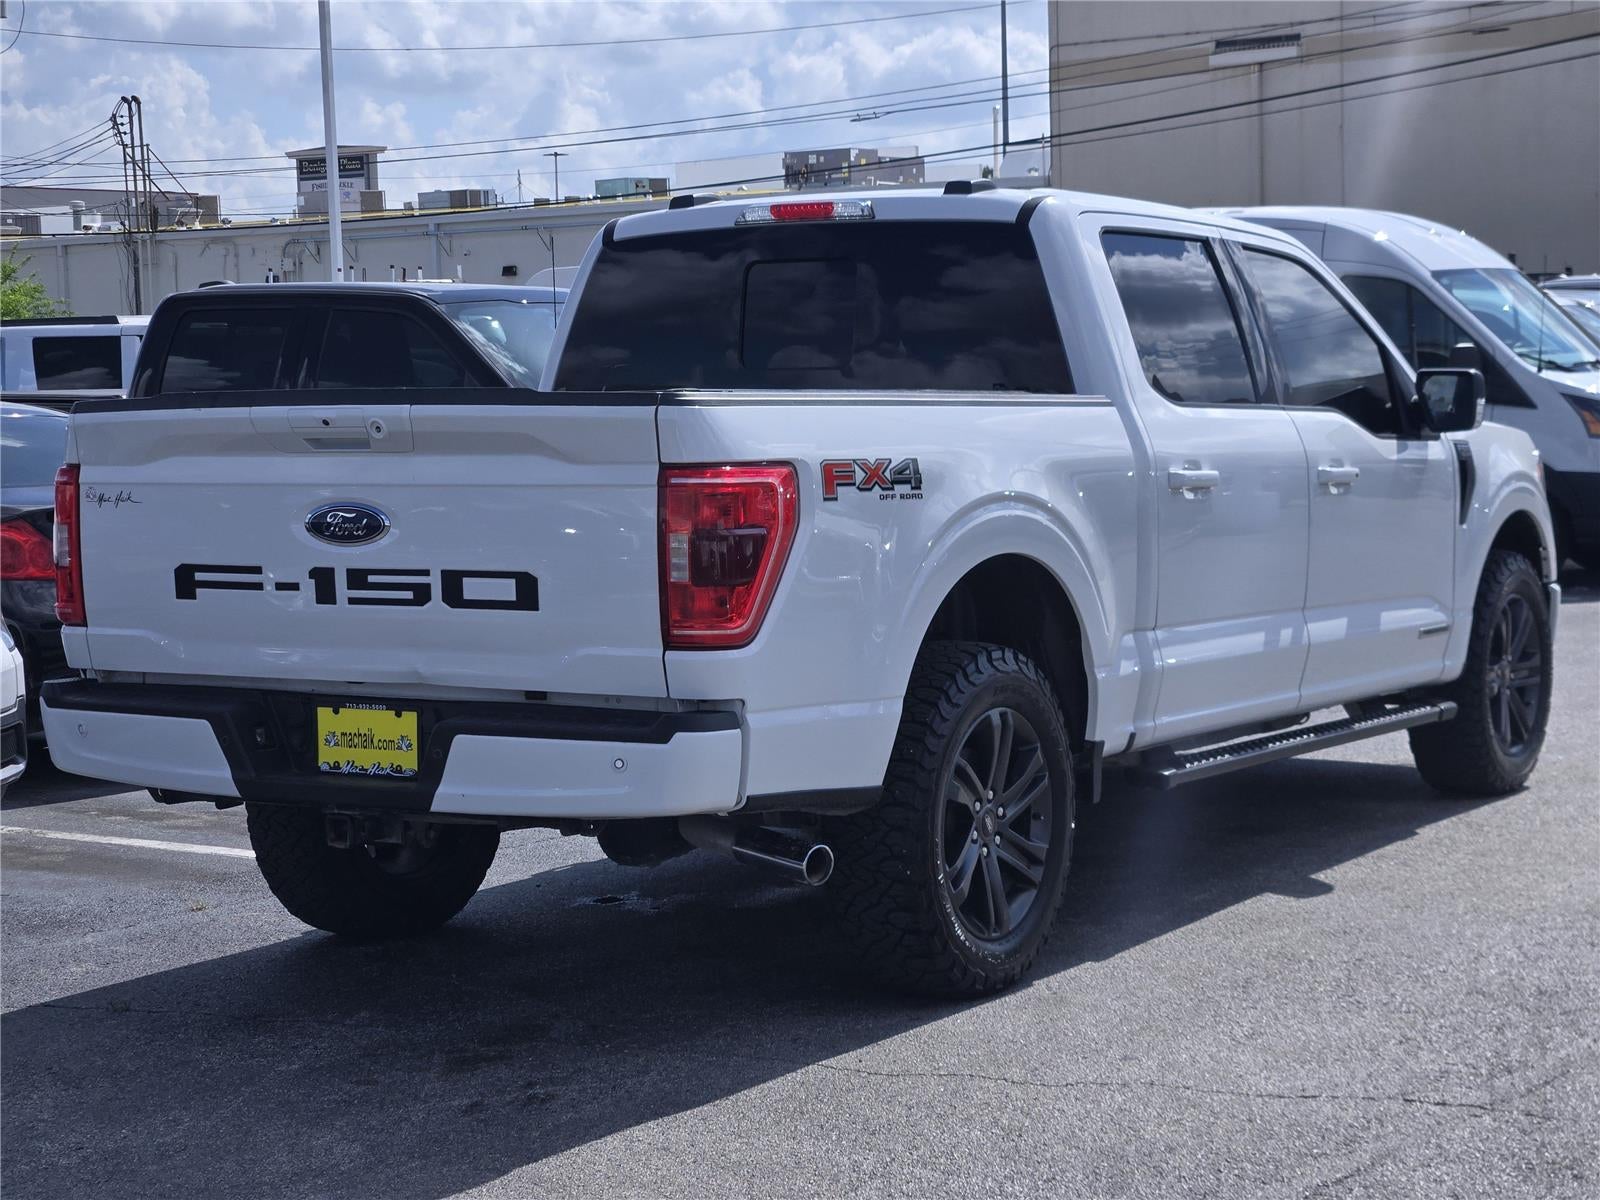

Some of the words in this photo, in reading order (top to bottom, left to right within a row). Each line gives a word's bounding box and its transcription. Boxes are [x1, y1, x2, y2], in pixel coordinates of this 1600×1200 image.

[820, 458, 922, 502] FX4
[879, 493, 897, 501] OFF
[899, 492, 924, 501] ROAD
[323, 511, 368, 536] Ford
[174, 563, 540, 611] F-150
[339, 727, 396, 751] machaik.com
[340, 760, 364, 774] Mac
